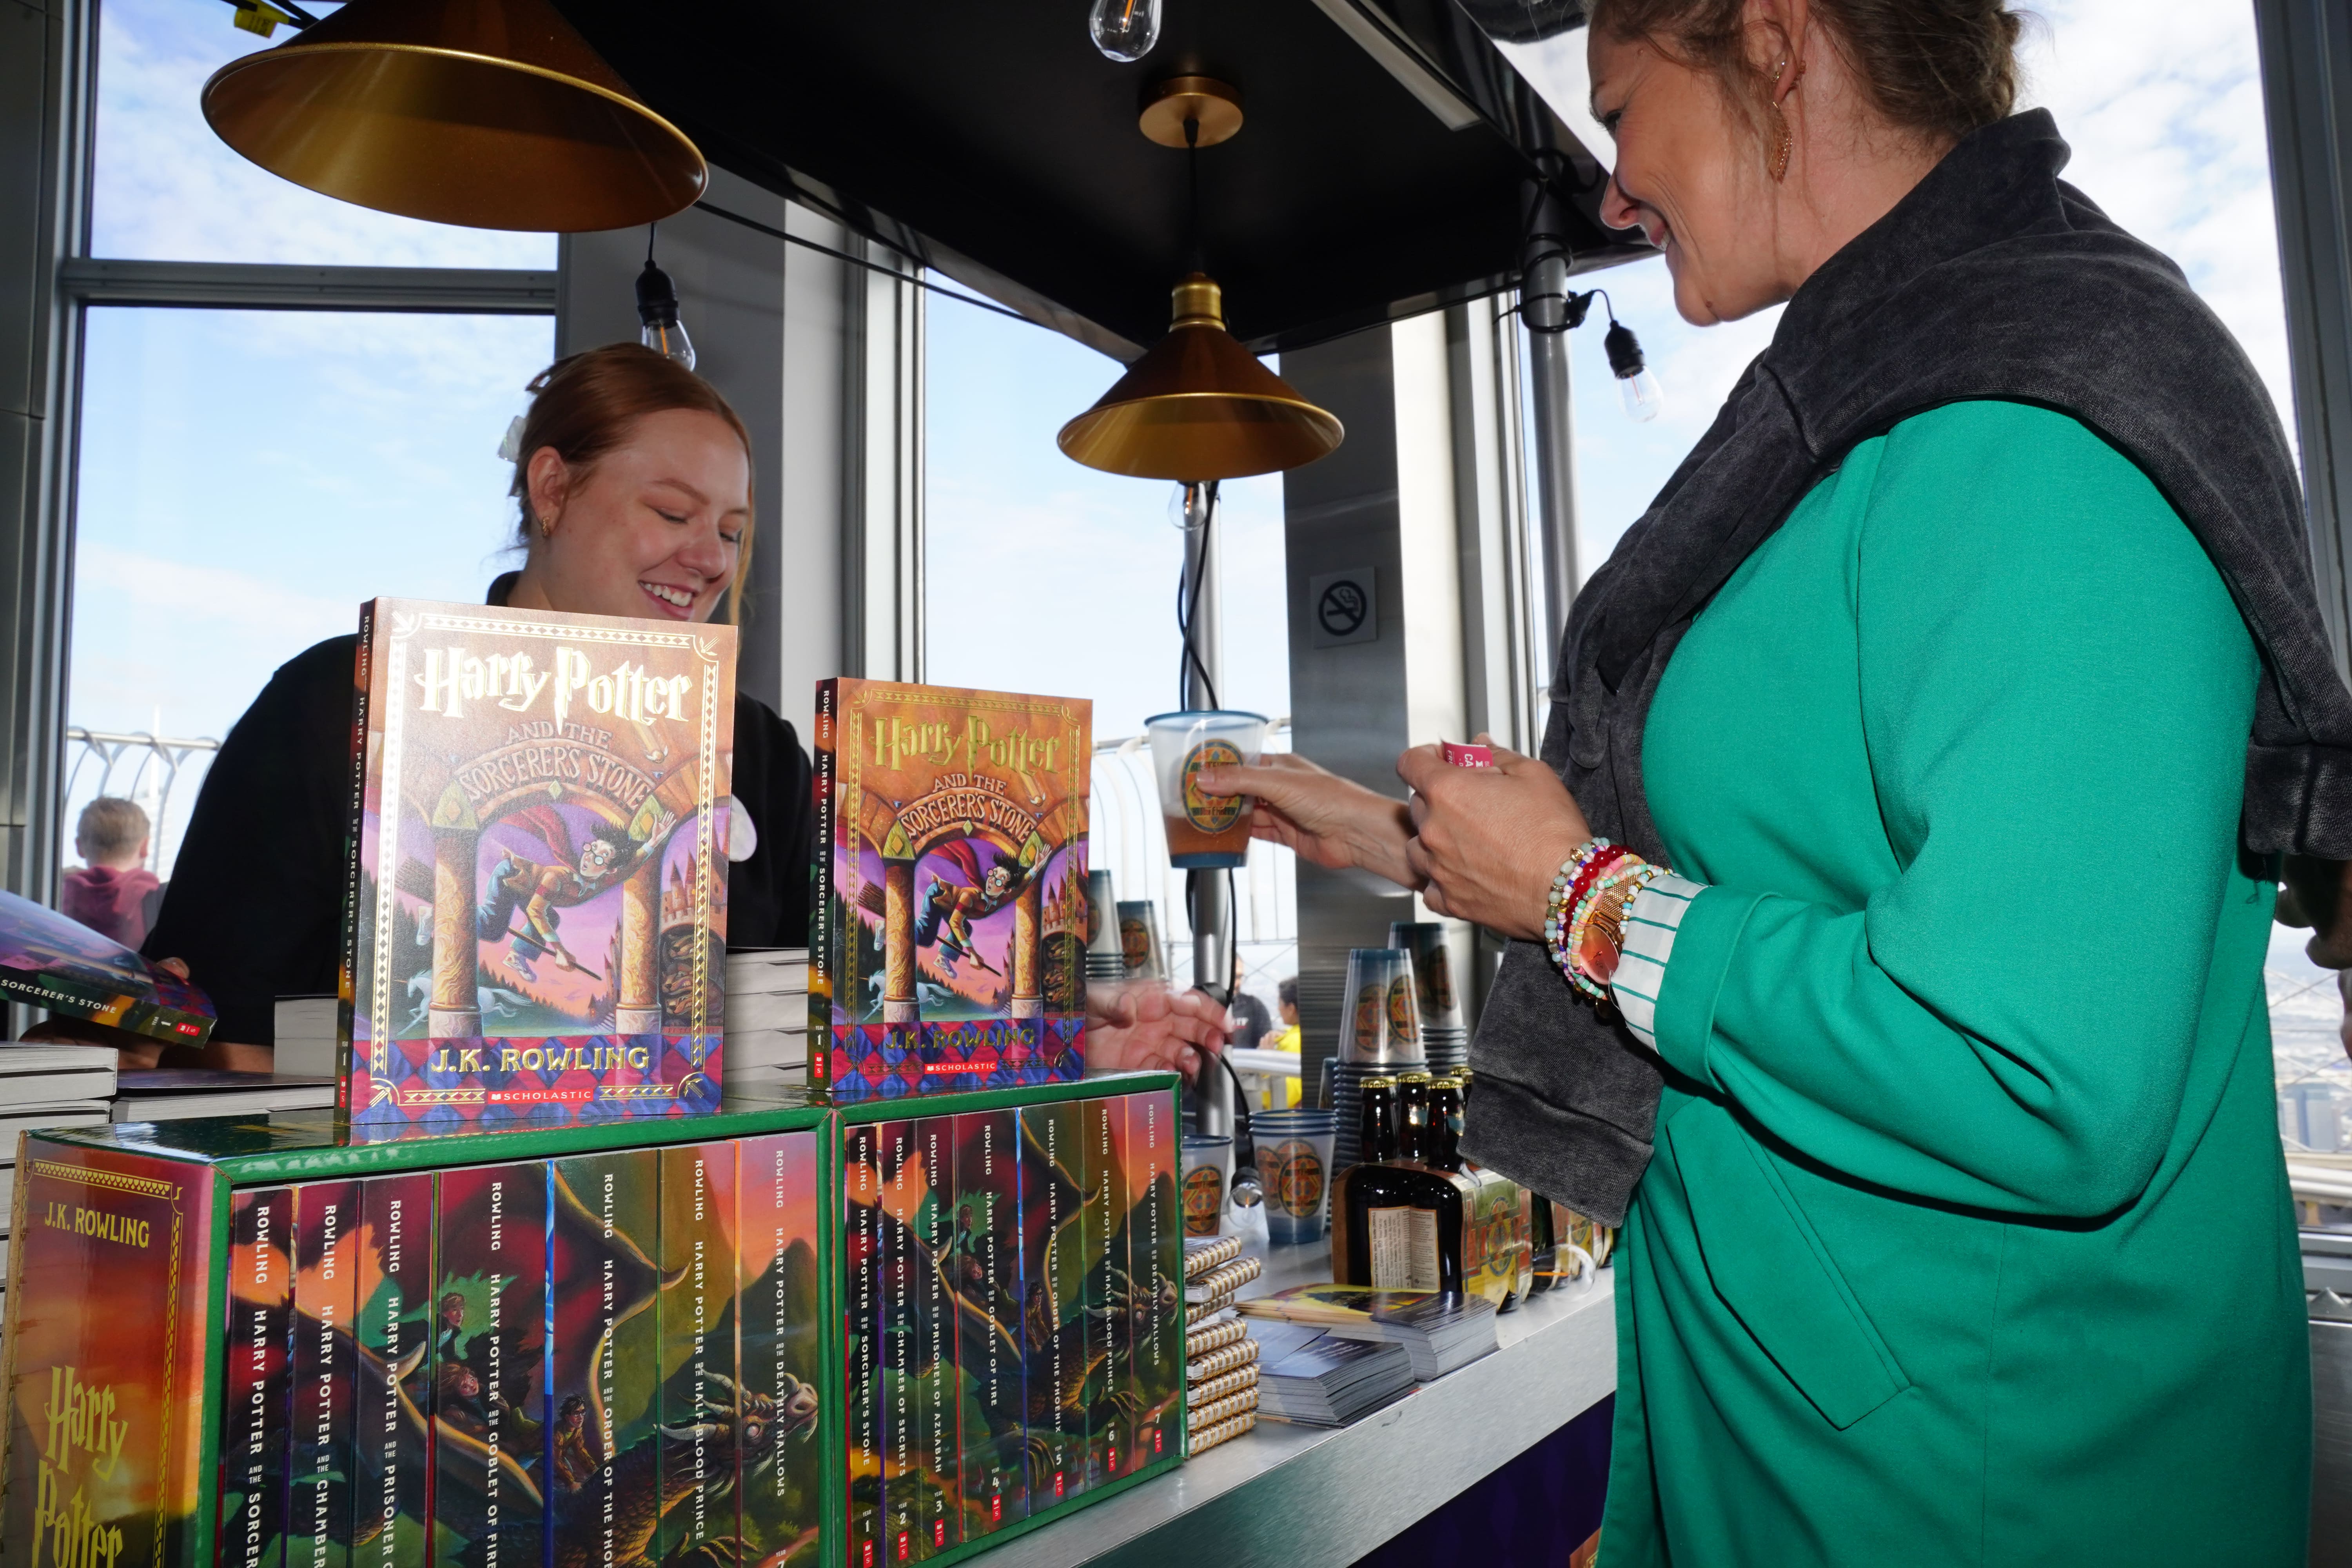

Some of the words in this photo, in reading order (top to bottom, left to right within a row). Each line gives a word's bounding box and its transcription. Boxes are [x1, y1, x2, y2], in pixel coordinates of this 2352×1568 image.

[413, 647, 552, 719] Harry
[554, 647, 693, 735] Potter
[358, 697, 366, 744] HARRY
[506, 721, 554, 746] AND
[566, 722, 613, 749] THE
[869, 716, 963, 771] Harry
[967, 715, 1060, 783] Potter
[460, 747, 582, 804] SORCERER'S
[587, 756, 653, 809] STONE
[932, 774, 967, 793] AND
[973, 773, 1007, 796] THE
[900, 792, 986, 838] SORCERER'S
[989, 799, 1035, 843] STONE
[348, 840, 357, 933] SORCERER'S
[1, 980, 76, 1003] SORCERER'S
[78, 999, 117, 1013] STONE
[818, 1034, 821, 1045] 1
[886, 1031, 926, 1050] J.K.
[933, 1028, 1036, 1048] ROWLING
[343, 1052, 346, 1066] 1
[430, 1047, 490, 1073] J.K.
[501, 1046, 649, 1072] ROWLING
[935, 1063, 995, 1071] SCHOLASTIC
[503, 1091, 591, 1101] SCHOLASTIC
[492, 1182, 501, 1251] ROWLING
[604, 1174, 613, 1238] ROWLING
[45, 1201, 71, 1230] J.K.
[75, 1207, 149, 1248] ROWLING
[390, 1200, 401, 1273] ROWLING
[256, 1206, 269, 1284] ROWLING
[324, 1205, 336, 1279] ROWLING
[490, 1274, 500, 1328] HARRY
[604, 1259, 613, 1311] HARRY
[253, 1310, 266, 1372] HARRY
[321, 1305, 333, 1365] HARRY
[387, 1297, 399, 1354] HARRY
[604, 1318, 612, 1379] POTTER
[1053, 1335, 1058, 1350] OF
[489, 1336, 499, 1401] POTTER
[990, 1358, 996, 1374] OF
[318, 1373, 331, 1446] POTTER
[385, 1363, 397, 1432] POTTER
[898, 1397, 905, 1414] OF
[934, 1391, 940, 1407] OF
[44, 1365, 128, 1483] Harry
[250, 1380, 264, 1455] POTTER
[1155, 1414, 1160, 1424] 7
[385, 1441, 396, 1450] AND
[604, 1408, 612, 1462] ORDER
[1109, 1431, 1114, 1441] 6
[249, 1465, 262, 1474] AND
[317, 1455, 329, 1463] AND
[317, 1464, 329, 1472] THE
[488, 1432, 498, 1498] GOBLET
[1056, 1454, 1061, 1465] 5
[249, 1475, 261, 1484] THE
[604, 1467, 612, 1487] OF
[993, 1477, 999, 1488] 4
[32, 1459, 123, 1568] Potter
[383, 1465, 395, 1556] PRISONER
[487, 1505, 497, 1527] OF
[604, 1492, 612, 1523] THE
[900, 1513, 906, 1524] 2
[936, 1500, 942, 1512] 3
[314, 1479, 328, 1568] CHAMBER
[866, 1520, 869, 1532] 1
[776, 1549, 786, 1557] YEAR
